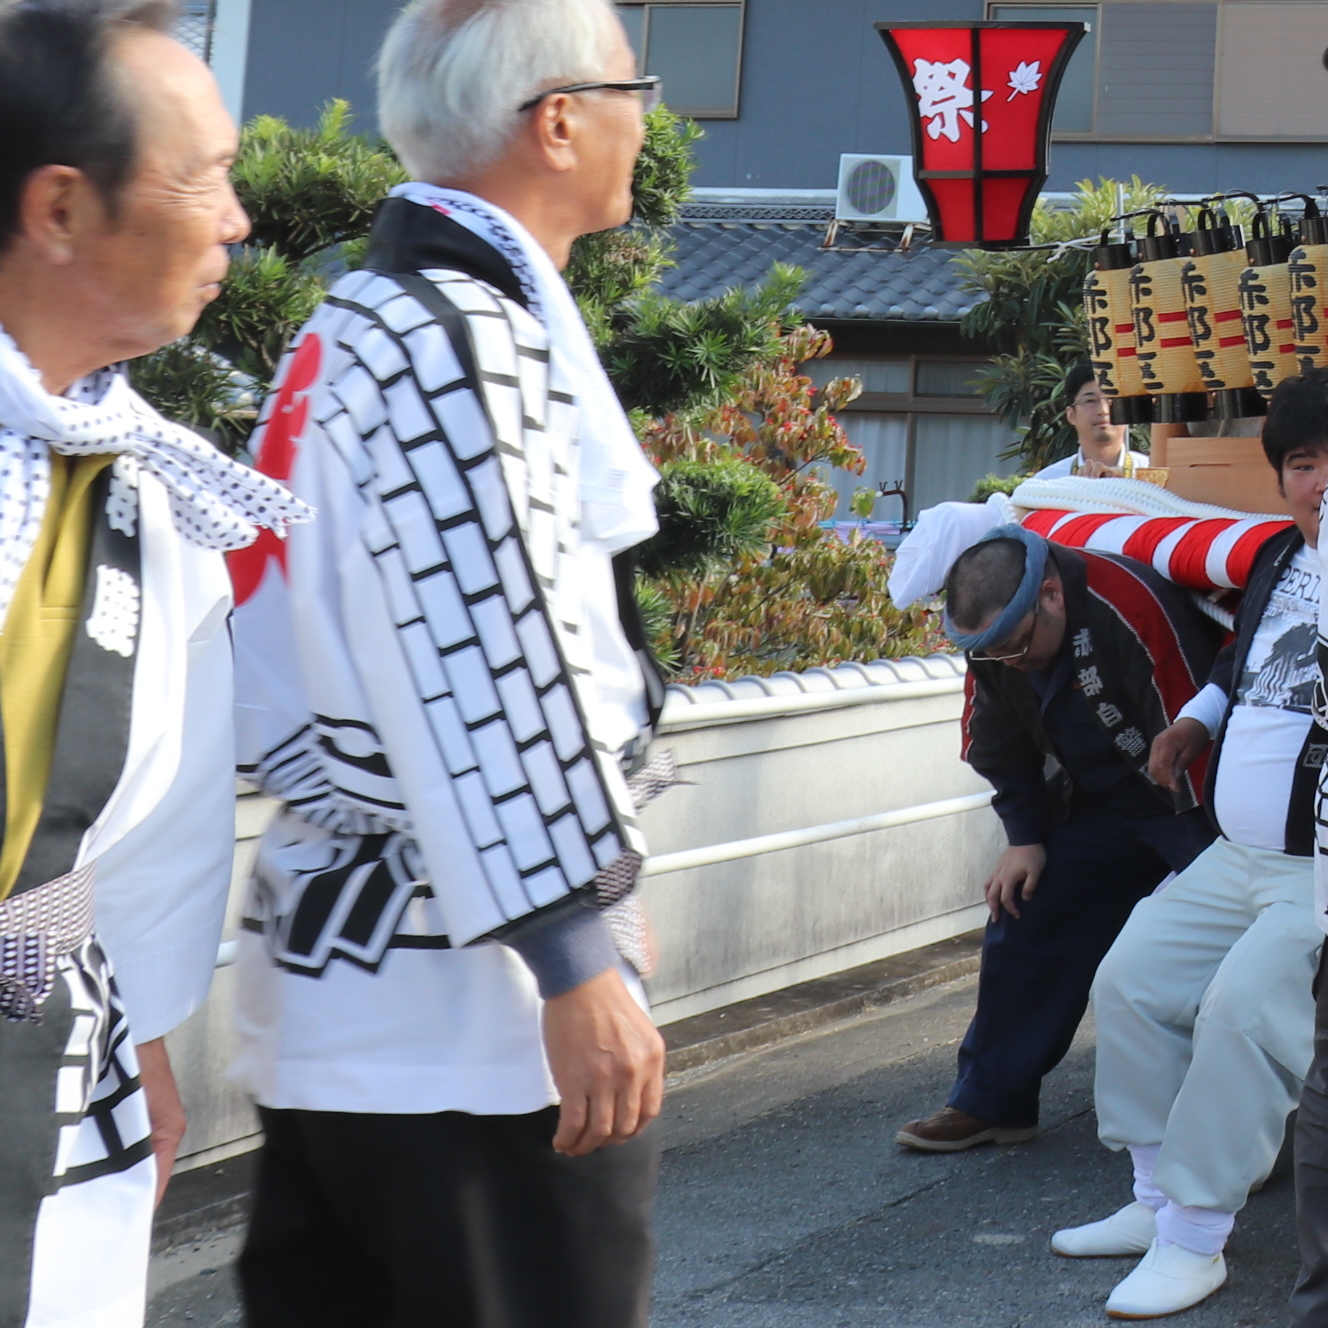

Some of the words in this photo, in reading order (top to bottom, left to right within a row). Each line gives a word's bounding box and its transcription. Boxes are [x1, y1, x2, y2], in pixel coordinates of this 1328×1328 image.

[912, 57, 992, 143] 祭
[1072, 627, 1157, 785] 赤部自警
